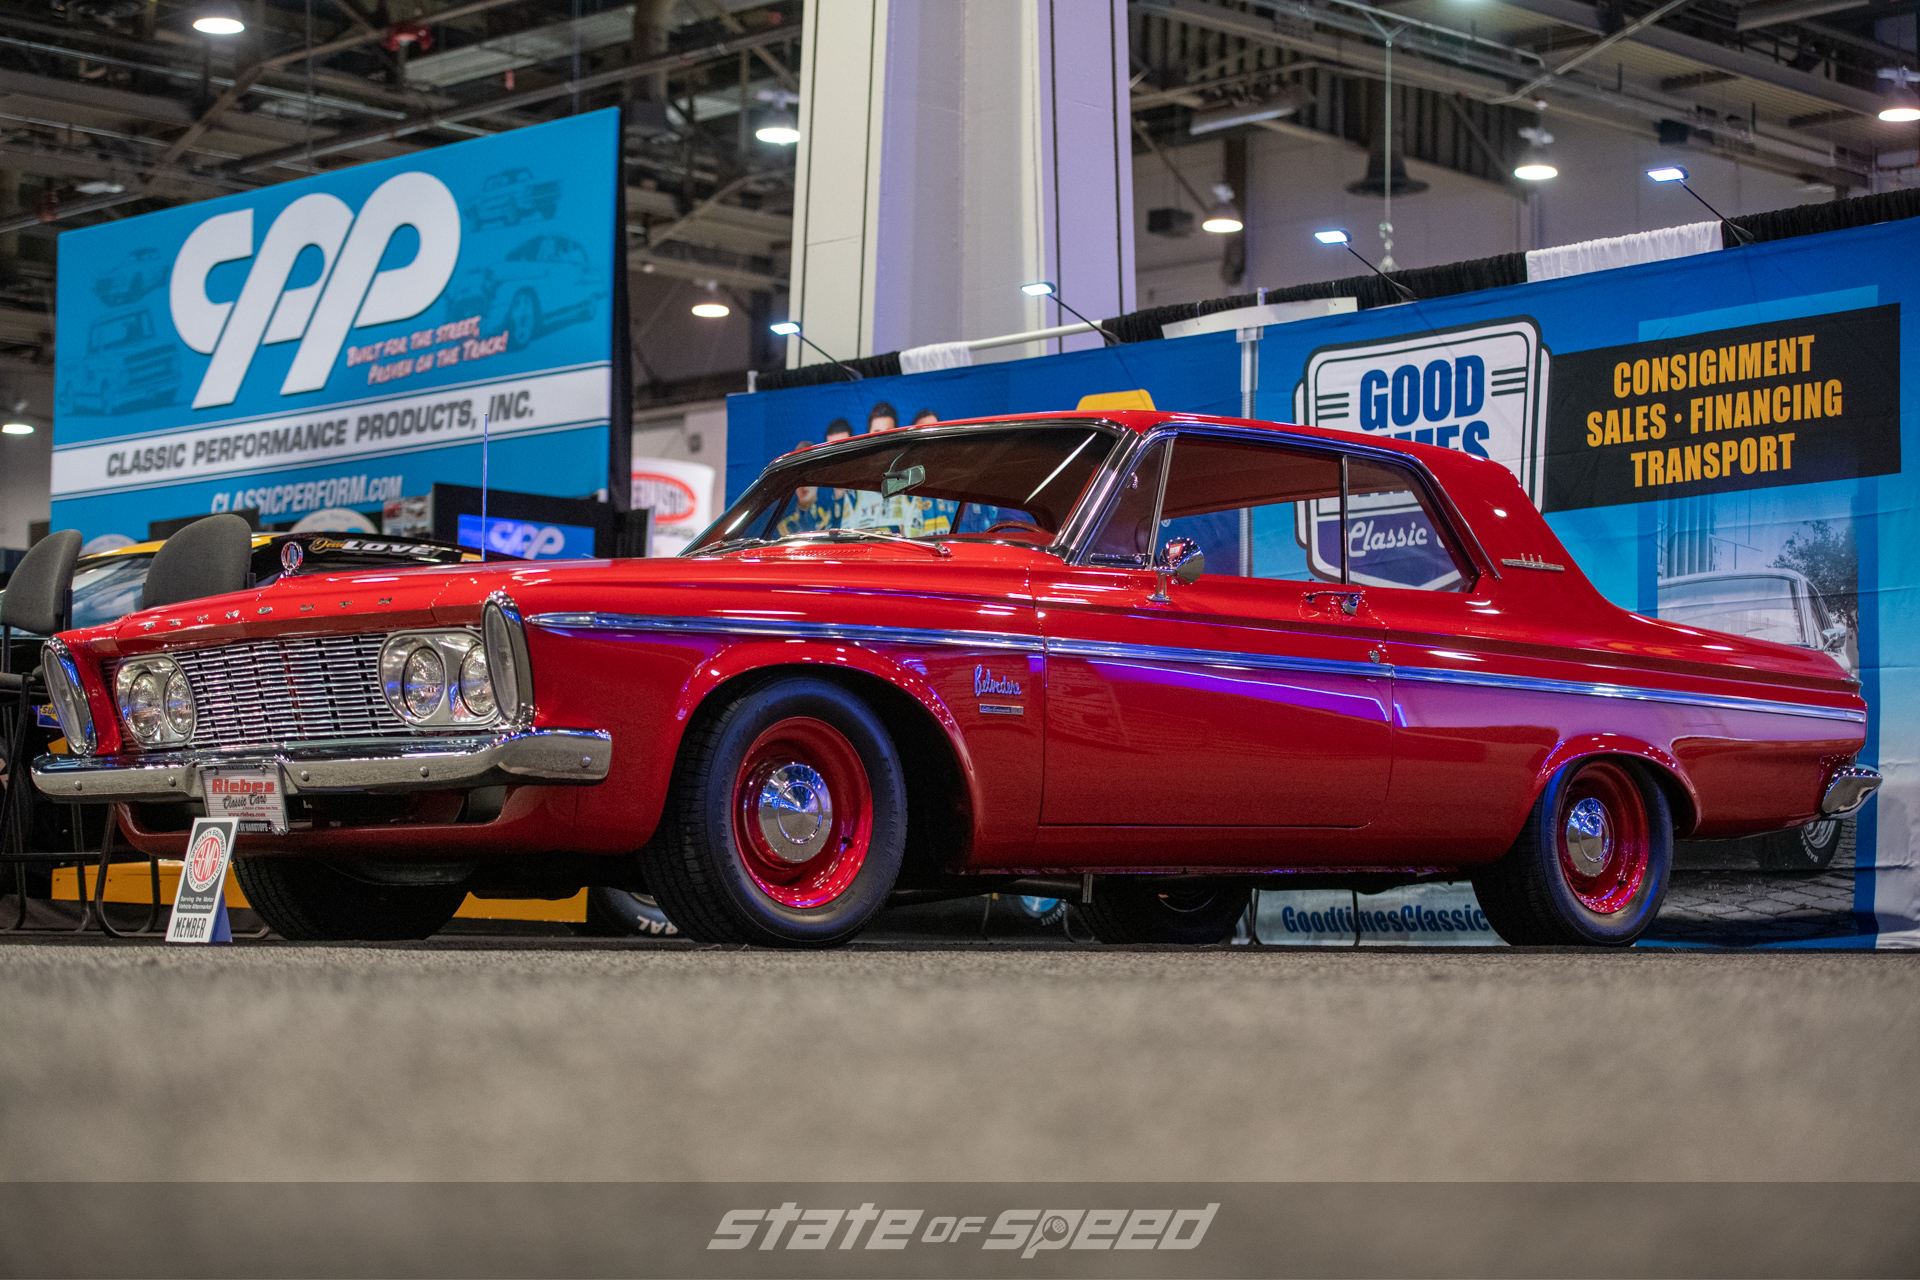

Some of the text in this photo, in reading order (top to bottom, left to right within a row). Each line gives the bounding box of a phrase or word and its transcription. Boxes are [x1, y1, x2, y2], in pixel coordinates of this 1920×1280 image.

[169, 171, 461, 410] CPP
[1359, 355, 1485, 432] GOOD
[1613, 334, 1815, 399] CONSIGNMENT
[106, 390, 536, 478] CLASSIC PERFORMANCE PRODUCTS, INC.
[1586, 379, 1843, 448] SALES FINANCING
[1630, 432, 1796, 488] TRANSPORT
[210, 474, 404, 516] CLASSICPERFORM.COM
[1349, 520, 1428, 558] Classic
[212, 778, 275, 793] Riebes
[173, 917, 207, 939] MEMBER
